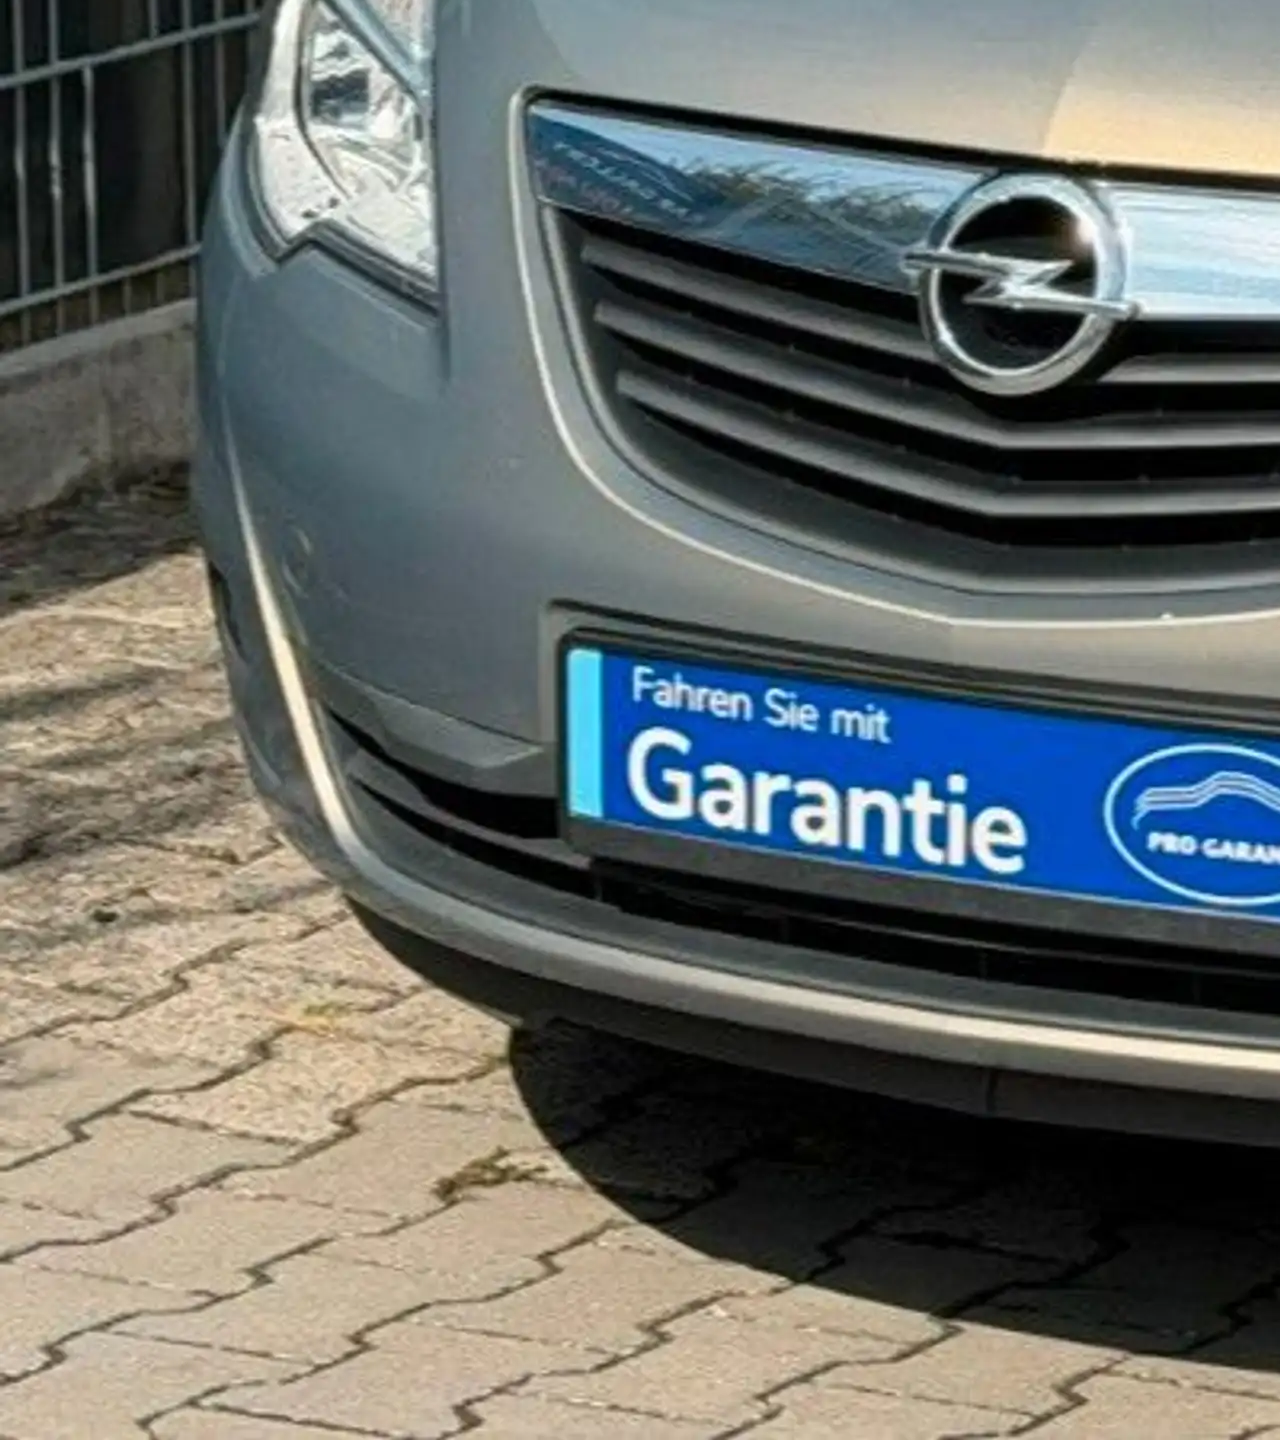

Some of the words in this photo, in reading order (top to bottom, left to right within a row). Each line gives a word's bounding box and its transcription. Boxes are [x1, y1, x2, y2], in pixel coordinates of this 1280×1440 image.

[632, 665, 754, 722] Fahren
[763, 687, 819, 733] Sie
[830, 703, 892, 745] mit
[627, 725, 1028, 875] Garantie
[1147, 831, 1196, 856] PRO
